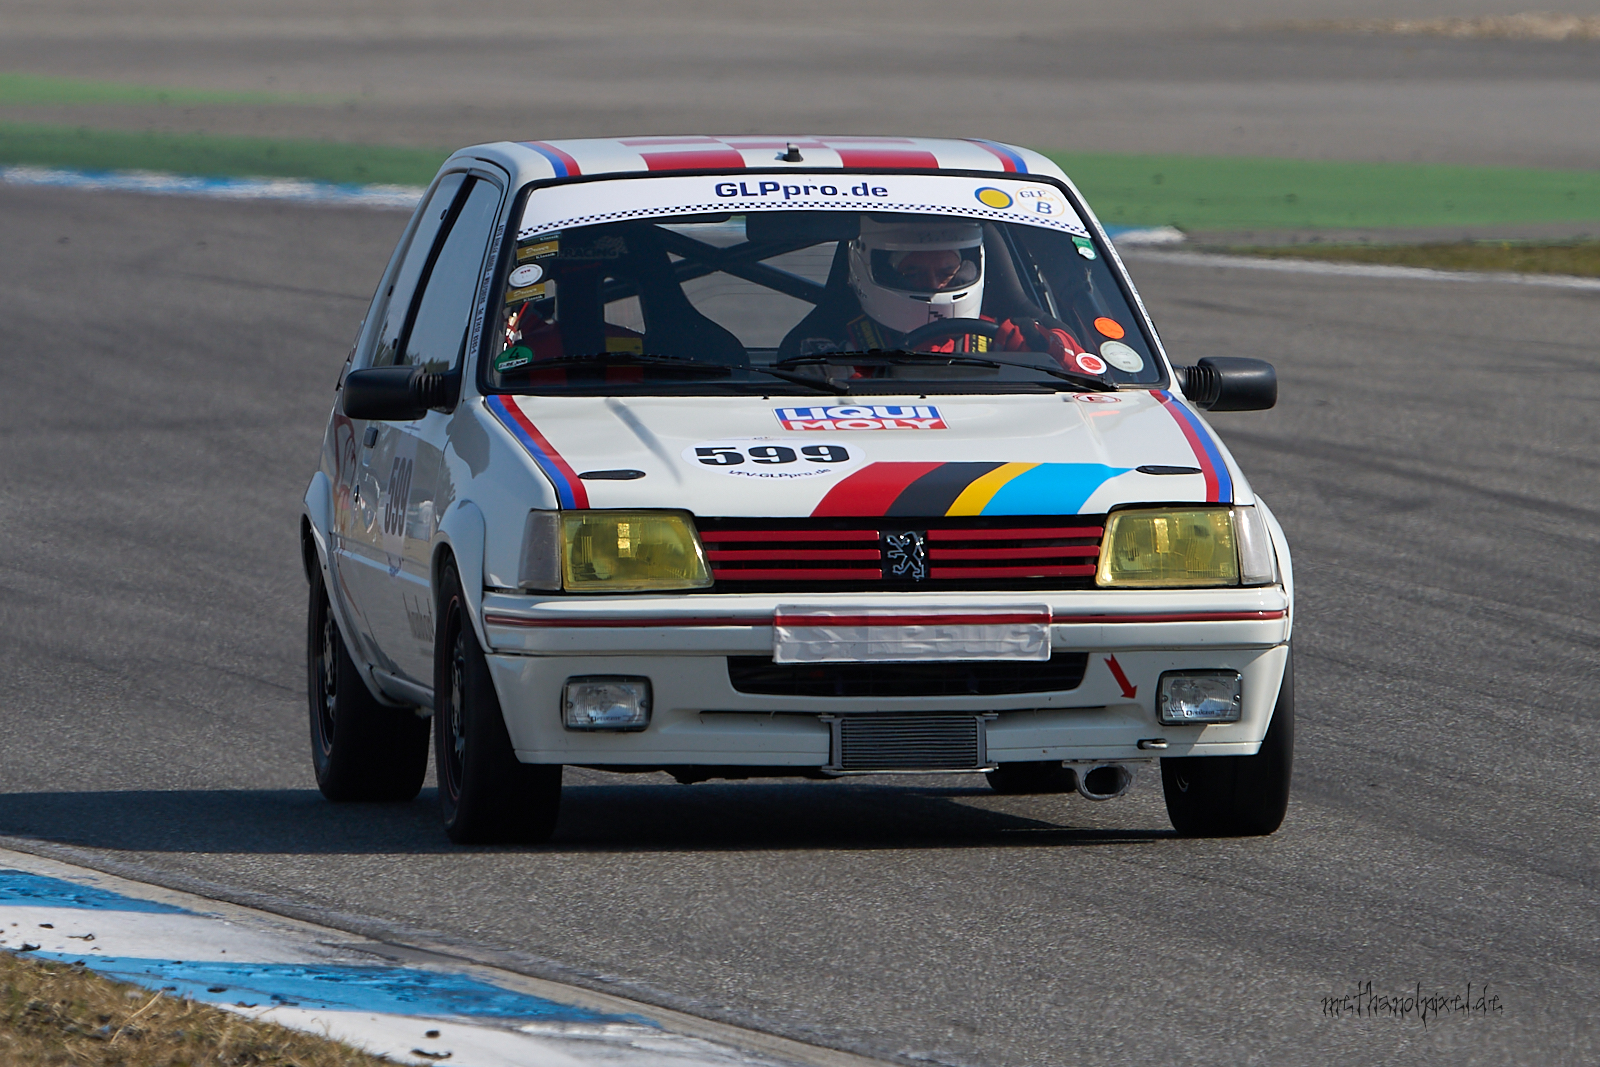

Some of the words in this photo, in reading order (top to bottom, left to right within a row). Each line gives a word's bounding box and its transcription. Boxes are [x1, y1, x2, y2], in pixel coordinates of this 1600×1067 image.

[715, 181, 888, 199] GLPpro.de
[1019, 190, 1046, 198] GLP
[1036, 201, 1052, 214] B
[508, 347, 520, 359] 4
[782, 406, 934, 420] LIQUI
[789, 419, 940, 430] MOLY
[694, 445, 850, 466] 599
[384, 456, 413, 537] 599
